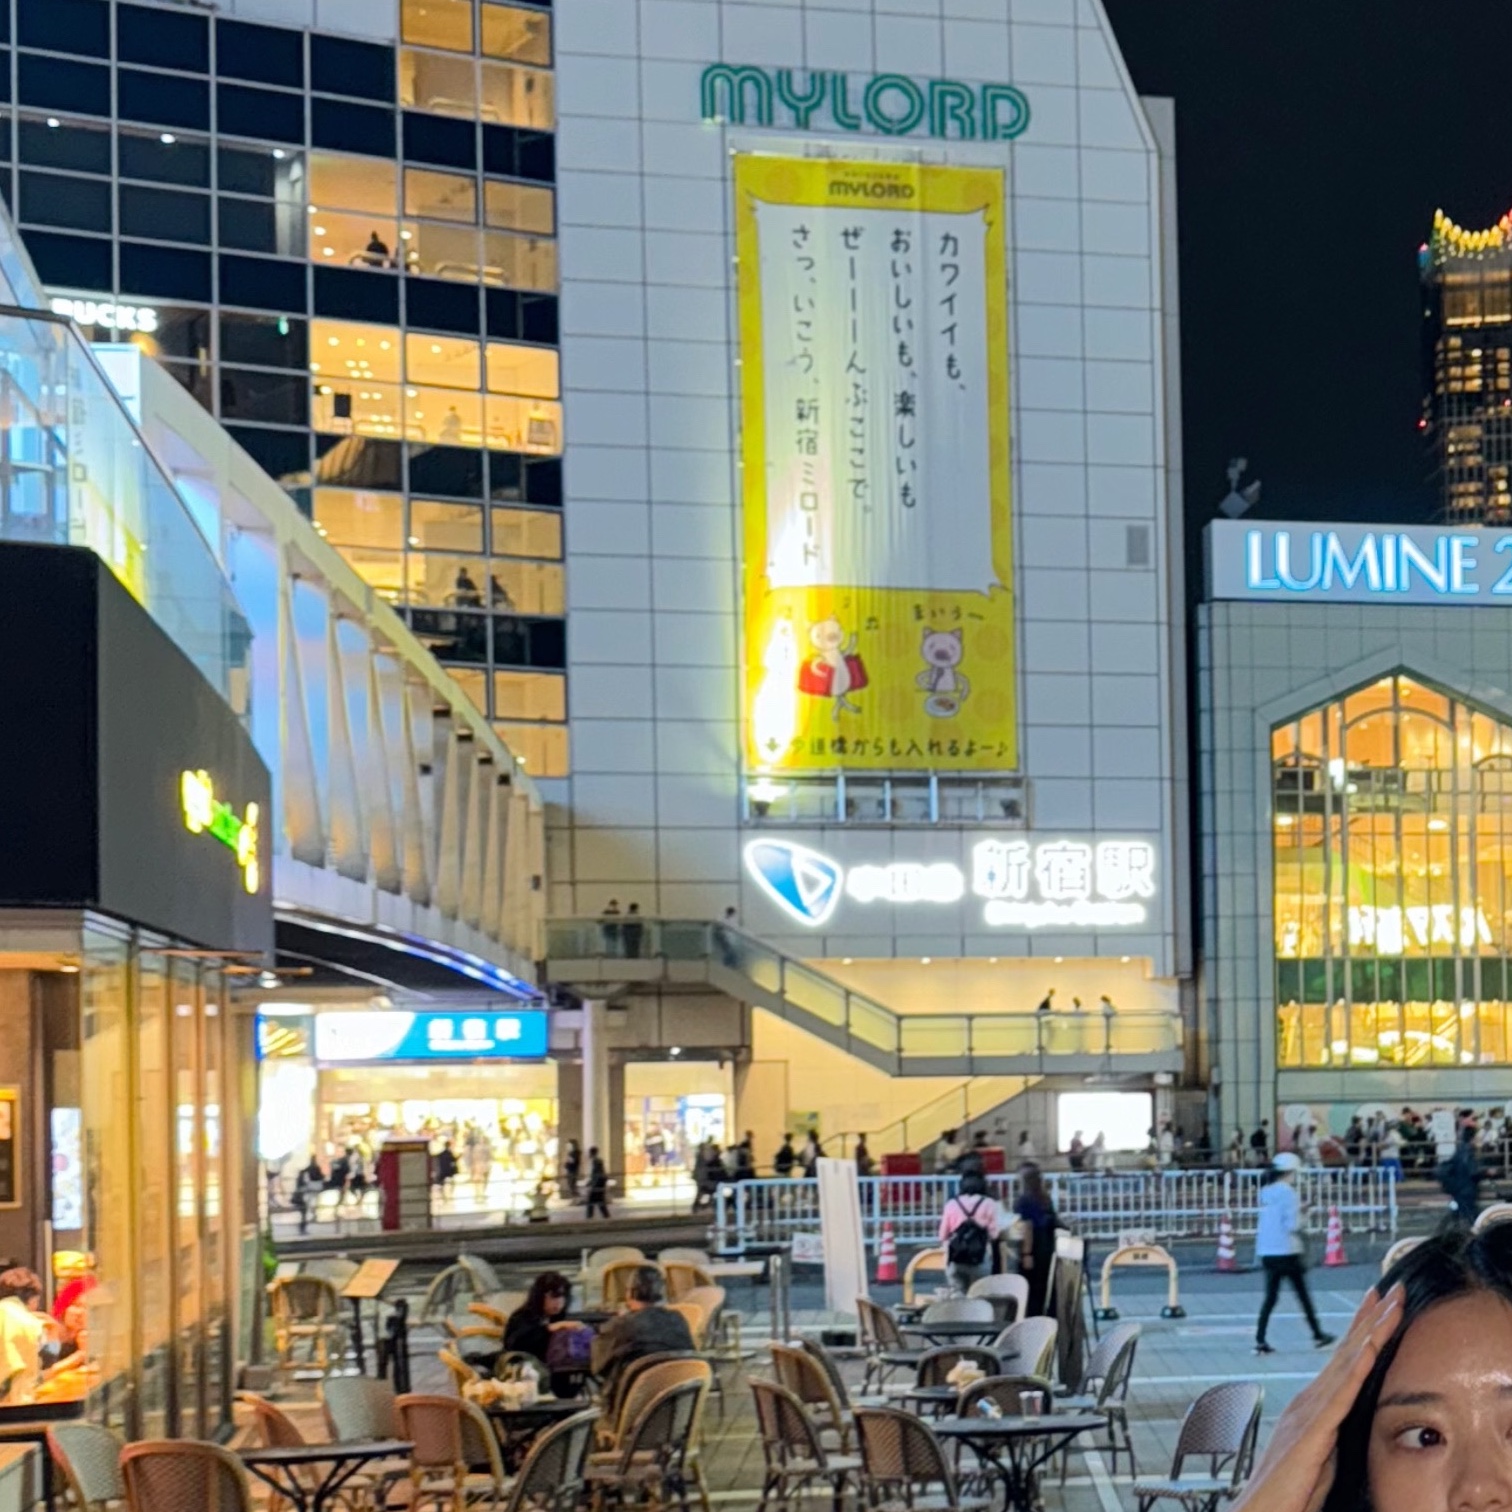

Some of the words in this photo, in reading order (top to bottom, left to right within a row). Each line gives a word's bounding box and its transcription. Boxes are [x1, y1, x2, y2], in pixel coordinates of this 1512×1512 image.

[700, 62, 1031, 140] MYLORD
[828, 180, 915, 199] MYLORD
[939, 232, 967, 390] カワイイも、
[890, 228, 917, 509] おいしいも、楽しいも
[1247, 530, 1480, 594] LUMINE
[972, 840, 1155, 898] 新宿駅
